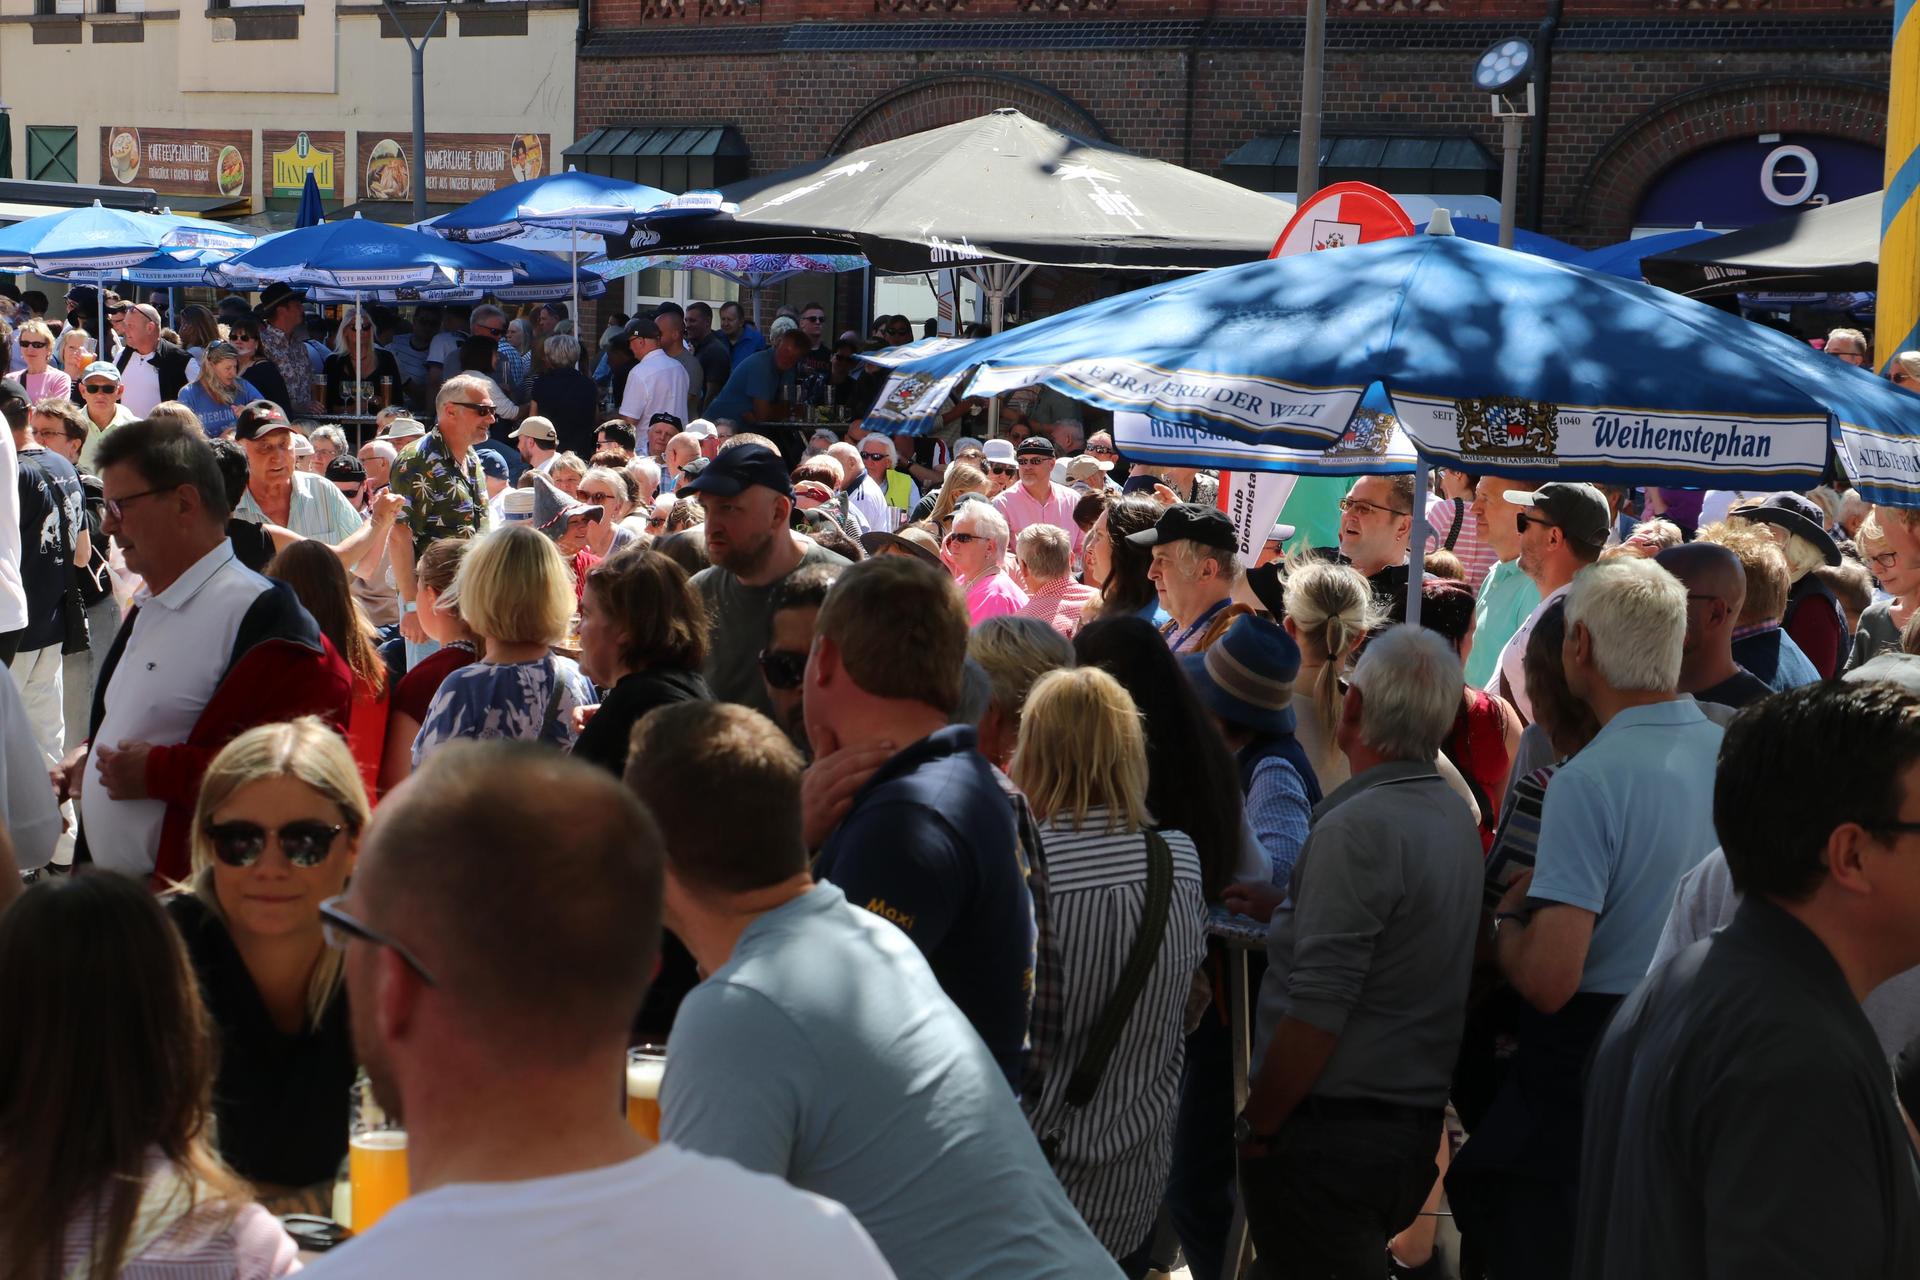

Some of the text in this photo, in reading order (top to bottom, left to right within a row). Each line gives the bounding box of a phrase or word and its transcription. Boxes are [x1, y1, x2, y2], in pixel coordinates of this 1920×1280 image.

[425, 148, 505, 171] NDWERKLICHE QUALITÄT
[1213, 386, 1263, 413] DER
[1269, 400, 1326, 420] WELT
[1432, 410, 1581, 426] SEIT 1040
[1592, 415, 1771, 461] Weihenstephan
[1461, 454, 1559, 466] BAYERISCHE STAATSBRAUEREI
[1240, 472, 1257, 555] Diemelsta
[865, 898, 915, 930] Maxi
